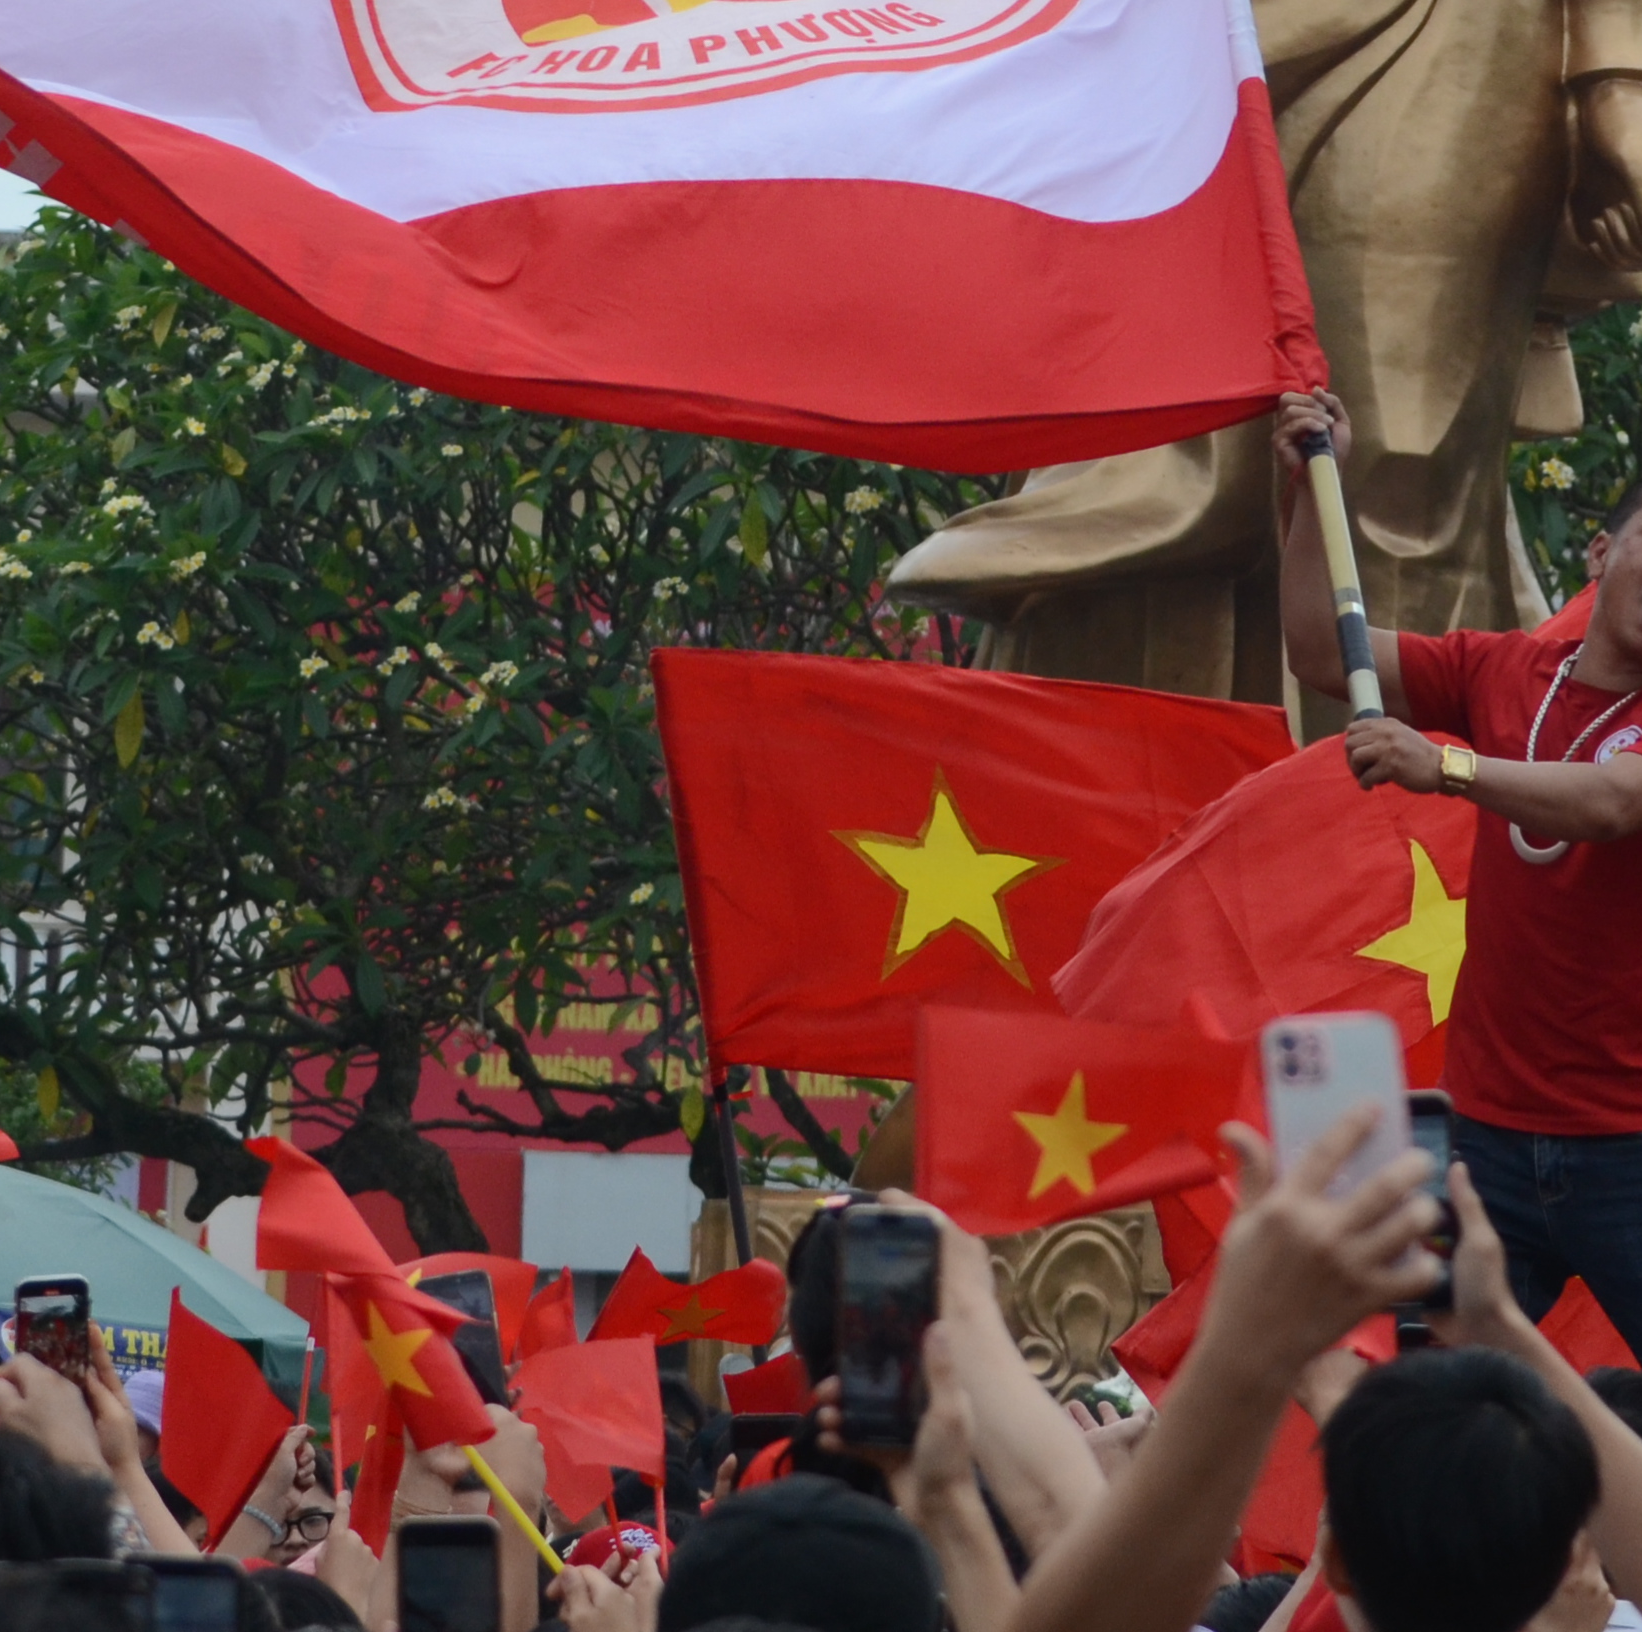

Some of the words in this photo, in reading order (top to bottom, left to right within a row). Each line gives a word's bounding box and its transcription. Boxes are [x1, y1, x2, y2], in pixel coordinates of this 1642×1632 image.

[445, 50, 528, 80] FC
[530, 40, 661, 75] HOA
[688, 1, 947, 65] PHƯỢNG
